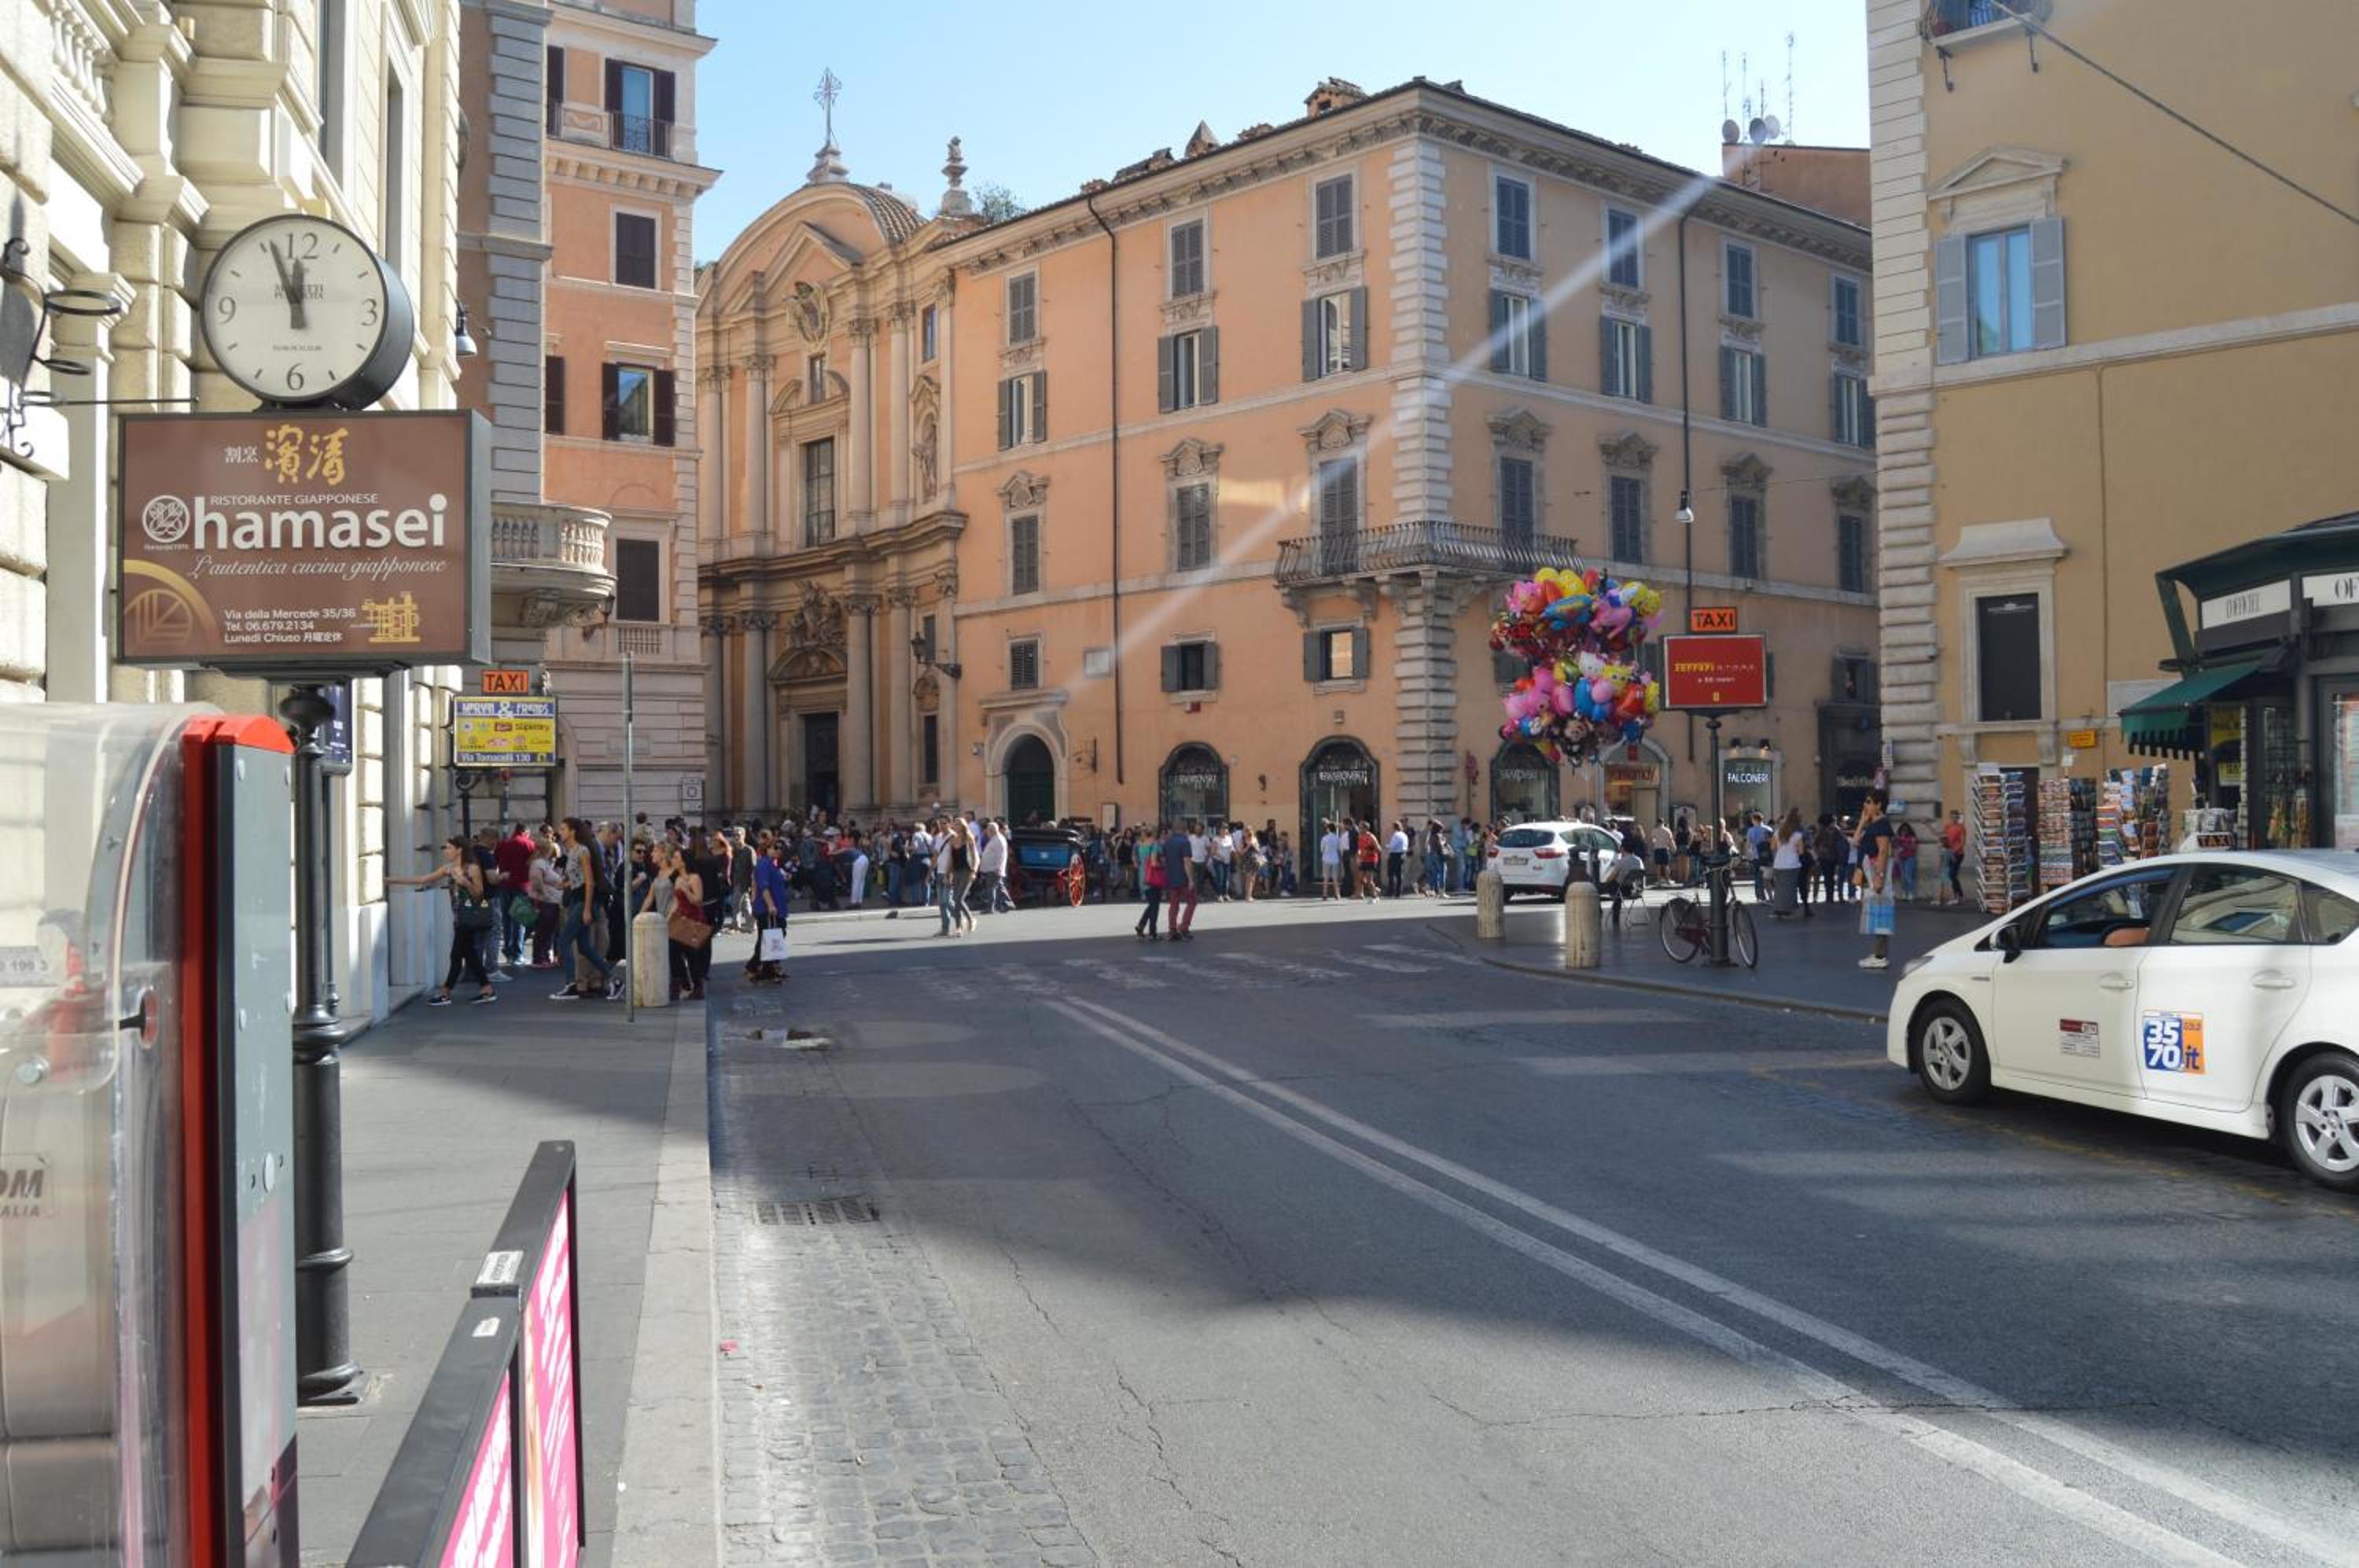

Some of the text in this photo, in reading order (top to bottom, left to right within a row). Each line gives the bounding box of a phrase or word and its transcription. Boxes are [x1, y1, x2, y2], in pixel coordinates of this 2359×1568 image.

[285, 232, 319, 260] 12
[218, 296, 236, 324] 9
[361, 298, 378, 326] 3
[286, 363, 304, 391] 6
[210, 492, 378, 506] RISTORANTE GIAPPONESE
[194, 493, 447, 550] hamasei
[292, 558, 344, 575] cucina
[341, 555, 446, 582] giapponese
[224, 609, 241, 620] Via
[245, 609, 270, 620] della
[273, 609, 319, 620] Mercede
[1694, 613, 1734, 628] TAXI
[263, 632, 301, 642] Chiuso
[485, 673, 524, 690] TAXI
[2199, 835, 2232, 848] TAXI
[2147, 1020, 2181, 1044] 35
[2147, 1043, 2181, 1069] 70
